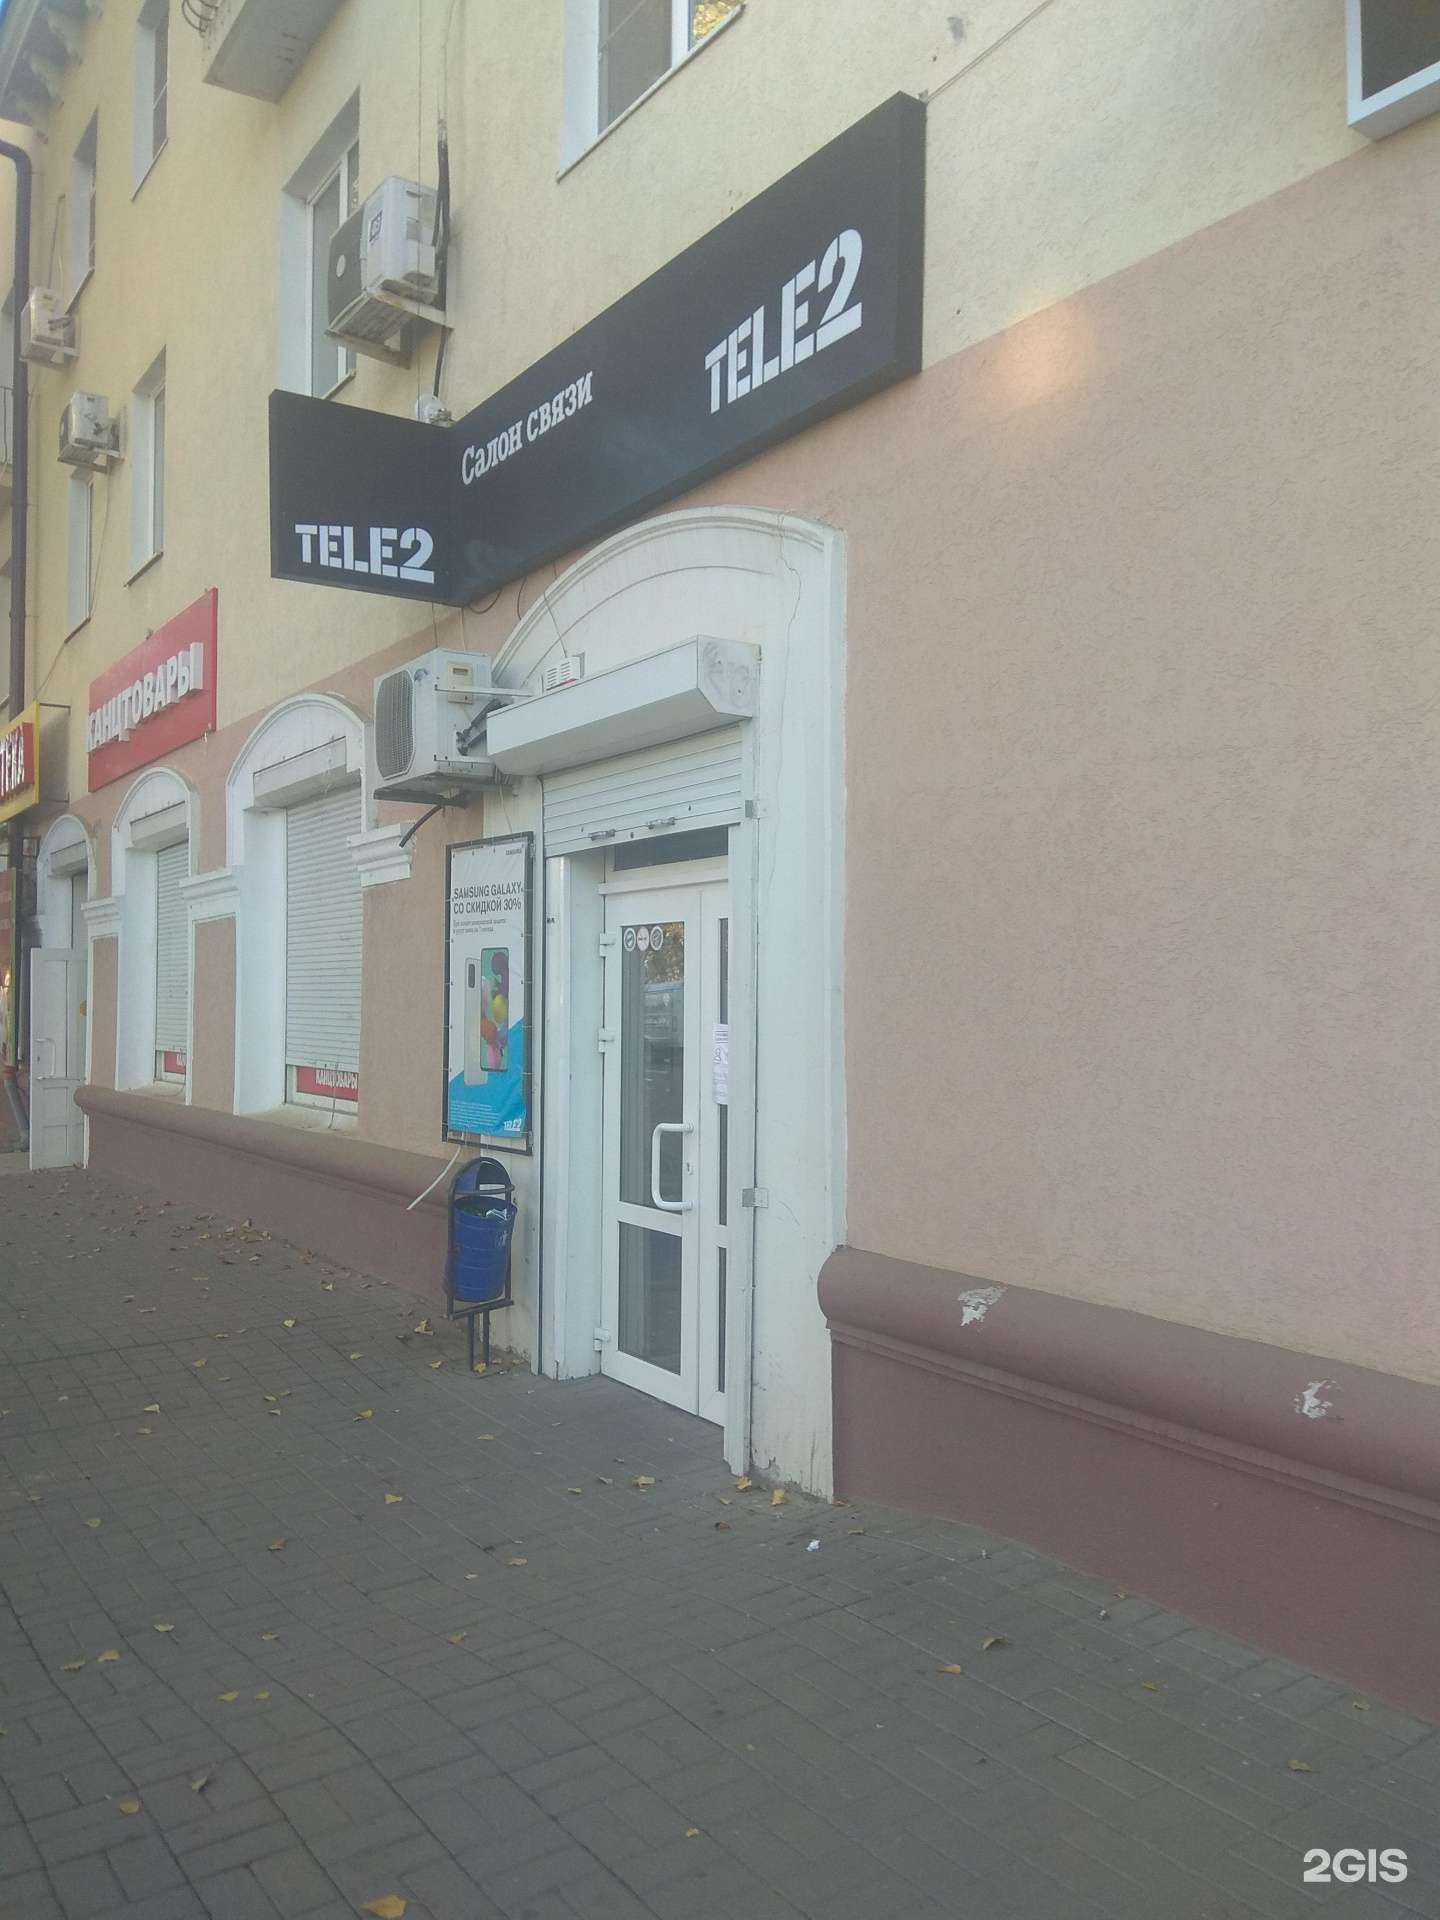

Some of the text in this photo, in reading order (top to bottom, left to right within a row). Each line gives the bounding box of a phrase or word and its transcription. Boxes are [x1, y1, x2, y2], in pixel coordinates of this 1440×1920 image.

[705, 229, 863, 414] TELE2
[462, 371, 593, 485] Салон связи
[295, 524, 435, 584] TELE2
[87, 642, 204, 753] КАНЦТОВАРЫ
[453, 881, 521, 899] SAMSUNG GALAXY
[453, 896, 521, 915] СО СКИДКОЙ 30%
